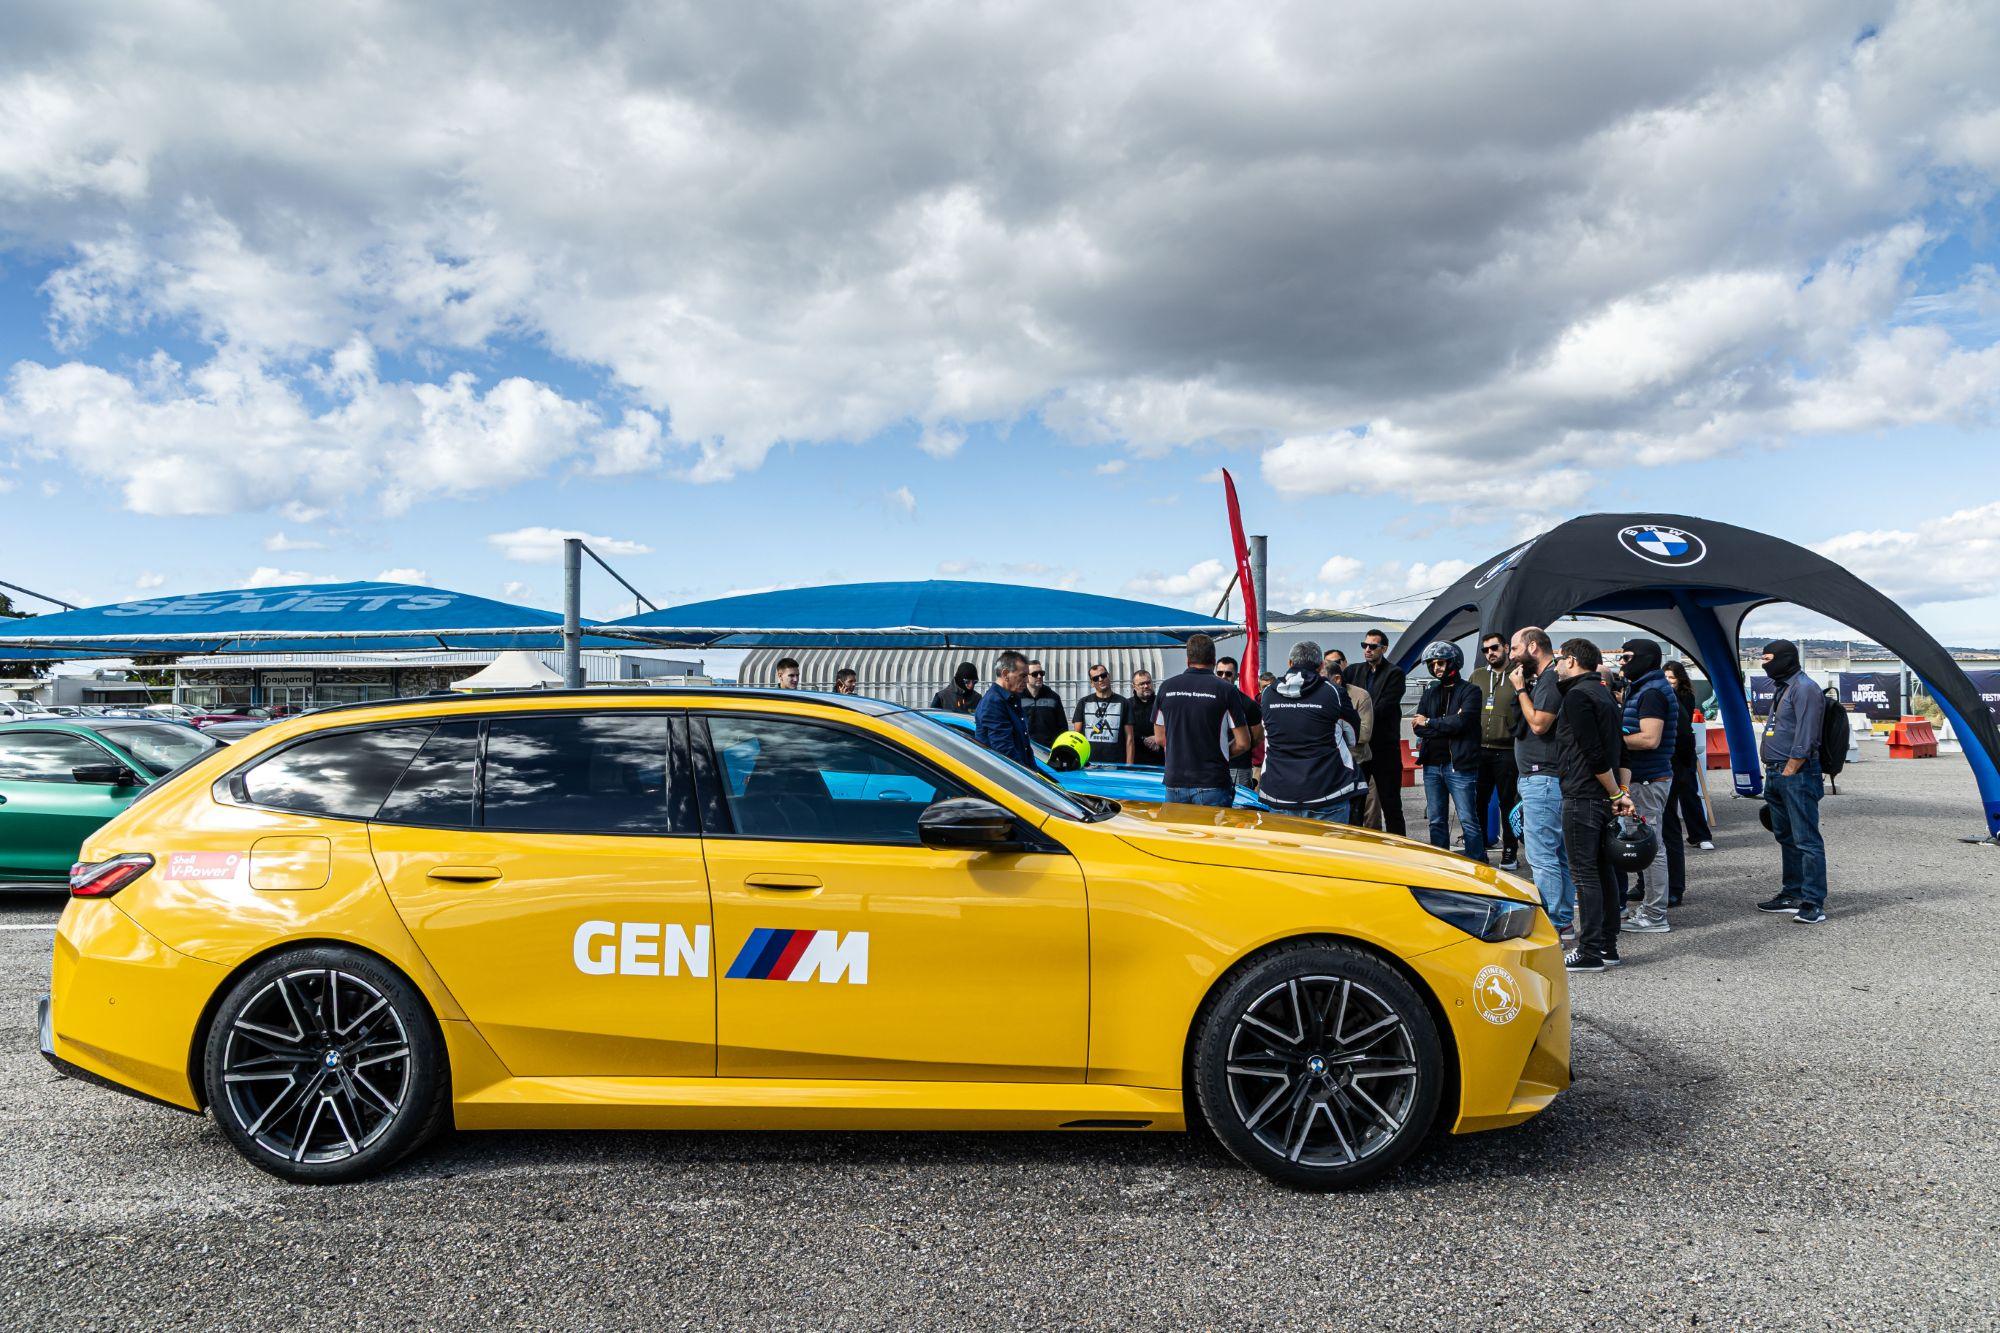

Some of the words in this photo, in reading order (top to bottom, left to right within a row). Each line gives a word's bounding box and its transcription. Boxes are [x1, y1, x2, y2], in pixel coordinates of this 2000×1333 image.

[1624, 526, 1685, 536] BMW
[102, 594, 459, 617] SEAJETS
[262, 673, 312, 685] Γραμματεία
[1857, 683, 1875, 691] DRIFT
[1192, 691, 1217, 699] Experience
[1851, 690, 1889, 702] HAPPENS.
[173, 855, 197, 864] Shell
[171, 864, 231, 877] V-Power
[573, 920, 711, 977] GEN
[343, 960, 396, 992] Continental
[1475, 967, 1514, 989] CONTINENTAL
[1482, 1010, 1504, 1023] SINCE
[1505, 1007, 1519, 1022] 1871
